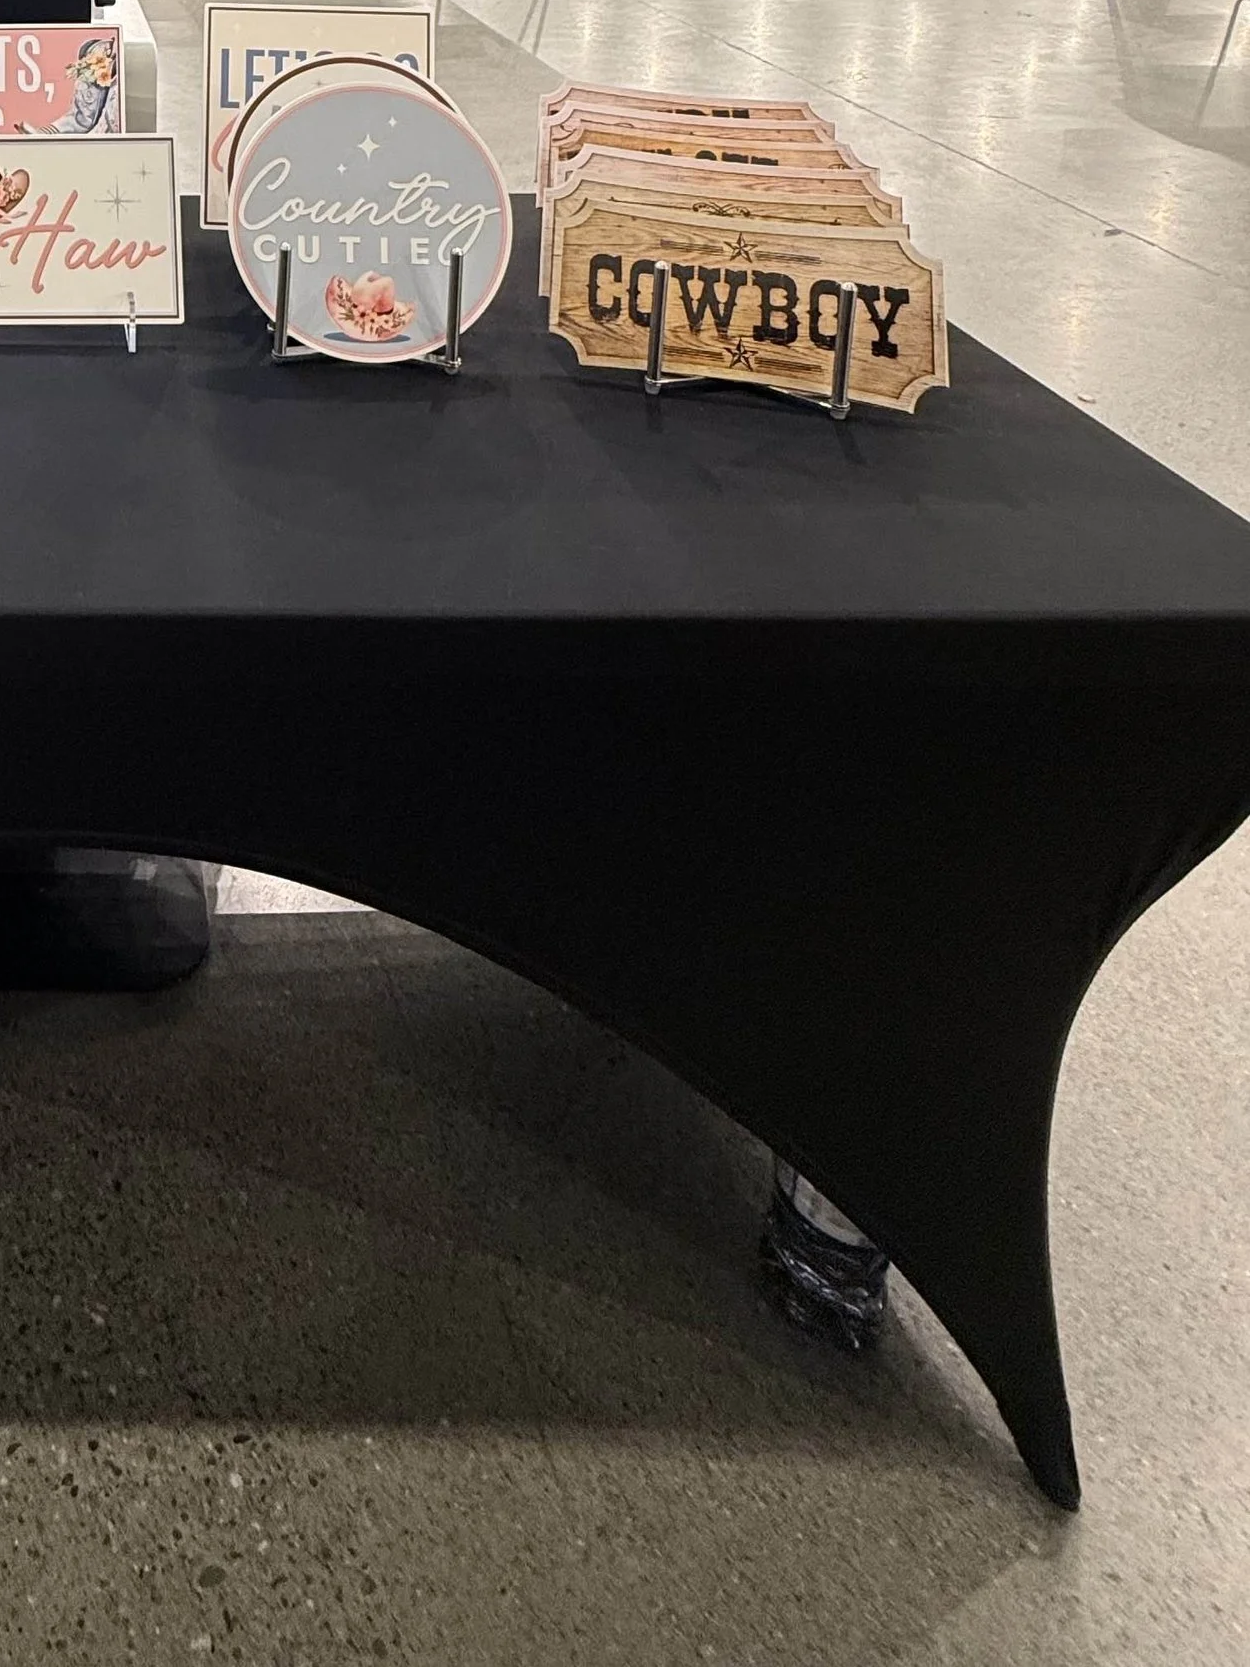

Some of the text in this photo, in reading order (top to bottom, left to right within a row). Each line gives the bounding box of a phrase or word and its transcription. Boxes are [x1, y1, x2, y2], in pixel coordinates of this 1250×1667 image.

[238, 157, 502, 267] Country
[252, 234, 431, 266] CUTIE
[587, 253, 911, 359] COWBOY
